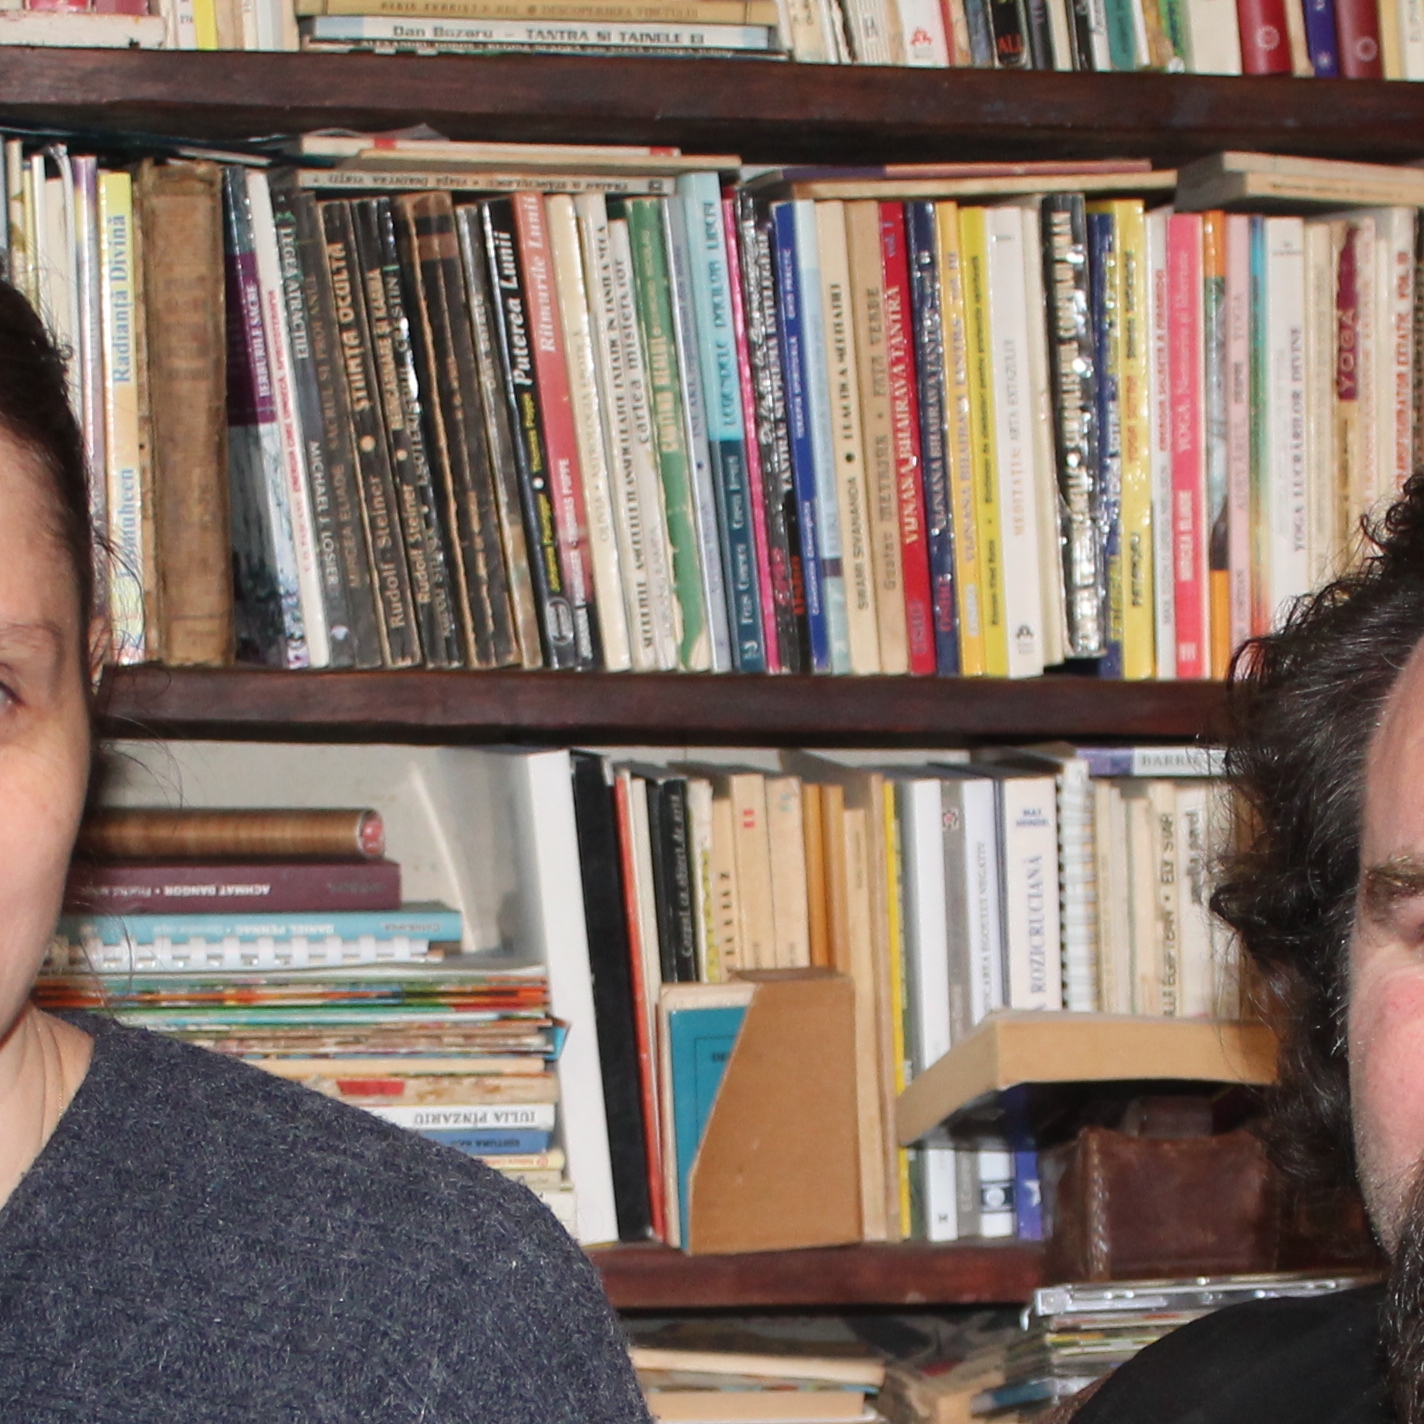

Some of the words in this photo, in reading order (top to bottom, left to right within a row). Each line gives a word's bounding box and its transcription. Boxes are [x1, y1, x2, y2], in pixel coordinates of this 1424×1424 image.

[392, 24, 425, 38] Dan
[526, 28, 589, 42] TANTRA
[619, 31, 681, 44] TAINELE
[106, 214, 130, 283] Divină
[521, 194, 546, 249] Lunii
[278, 225, 300, 279] LEGEA
[493, 231, 519, 290] Lunii
[781, 248, 796, 291] PRACTIC
[530, 256, 556, 353] Ritmurile
[885, 284, 905, 360] TANTRA
[1231, 291, 1246, 342] YOGA
[503, 297, 534, 387] Puterea
[1289, 325, 1303, 383] DIVINE
[1339, 308, 1356, 392] YOGA
[521, 391, 538, 428] Poppe
[628, 379, 650, 445] cartea
[891, 363, 917, 461] BHAIRAVA
[1007, 408, 1022, 443] ARTA
[526, 429, 543, 474] Thomas
[1289, 390, 1305, 498] LUCRĂRILOR
[309, 440, 329, 502] MICHAEL
[321, 517, 340, 585] LOSIER
[331, 464, 353, 520] ELIADE
[366, 473, 394, 548] Steiner
[399, 483, 423, 544] Steiner
[845, 475, 868, 560] SIVANANDA
[1177, 489, 1193, 535] ELIADE
[1292, 505, 1305, 552] YOGA
[339, 525, 361, 588] MIRCEA
[408, 549, 432, 605] Rudolf
[1178, 536, 1195, 582] MIRCEA
[382, 561, 407, 628] Rudolf
[851, 561, 870, 611] SWAMI
[1159, 812, 1175, 853] STAR
[164, 884, 217, 897] DANGOR
[219, 883, 272, 897] ACHMAT
[1160, 856, 1175, 885] ELY
[235, 924, 287, 936] PENNAC
[289, 923, 335, 936] DANIEL
[678, 909, 695, 958] Corpul
[1022, 854, 1047, 994] ROZICRUCIANĂ
[474, 1138, 521, 1149] EDITURA
[490, 1110, 537, 1126] IULIA
